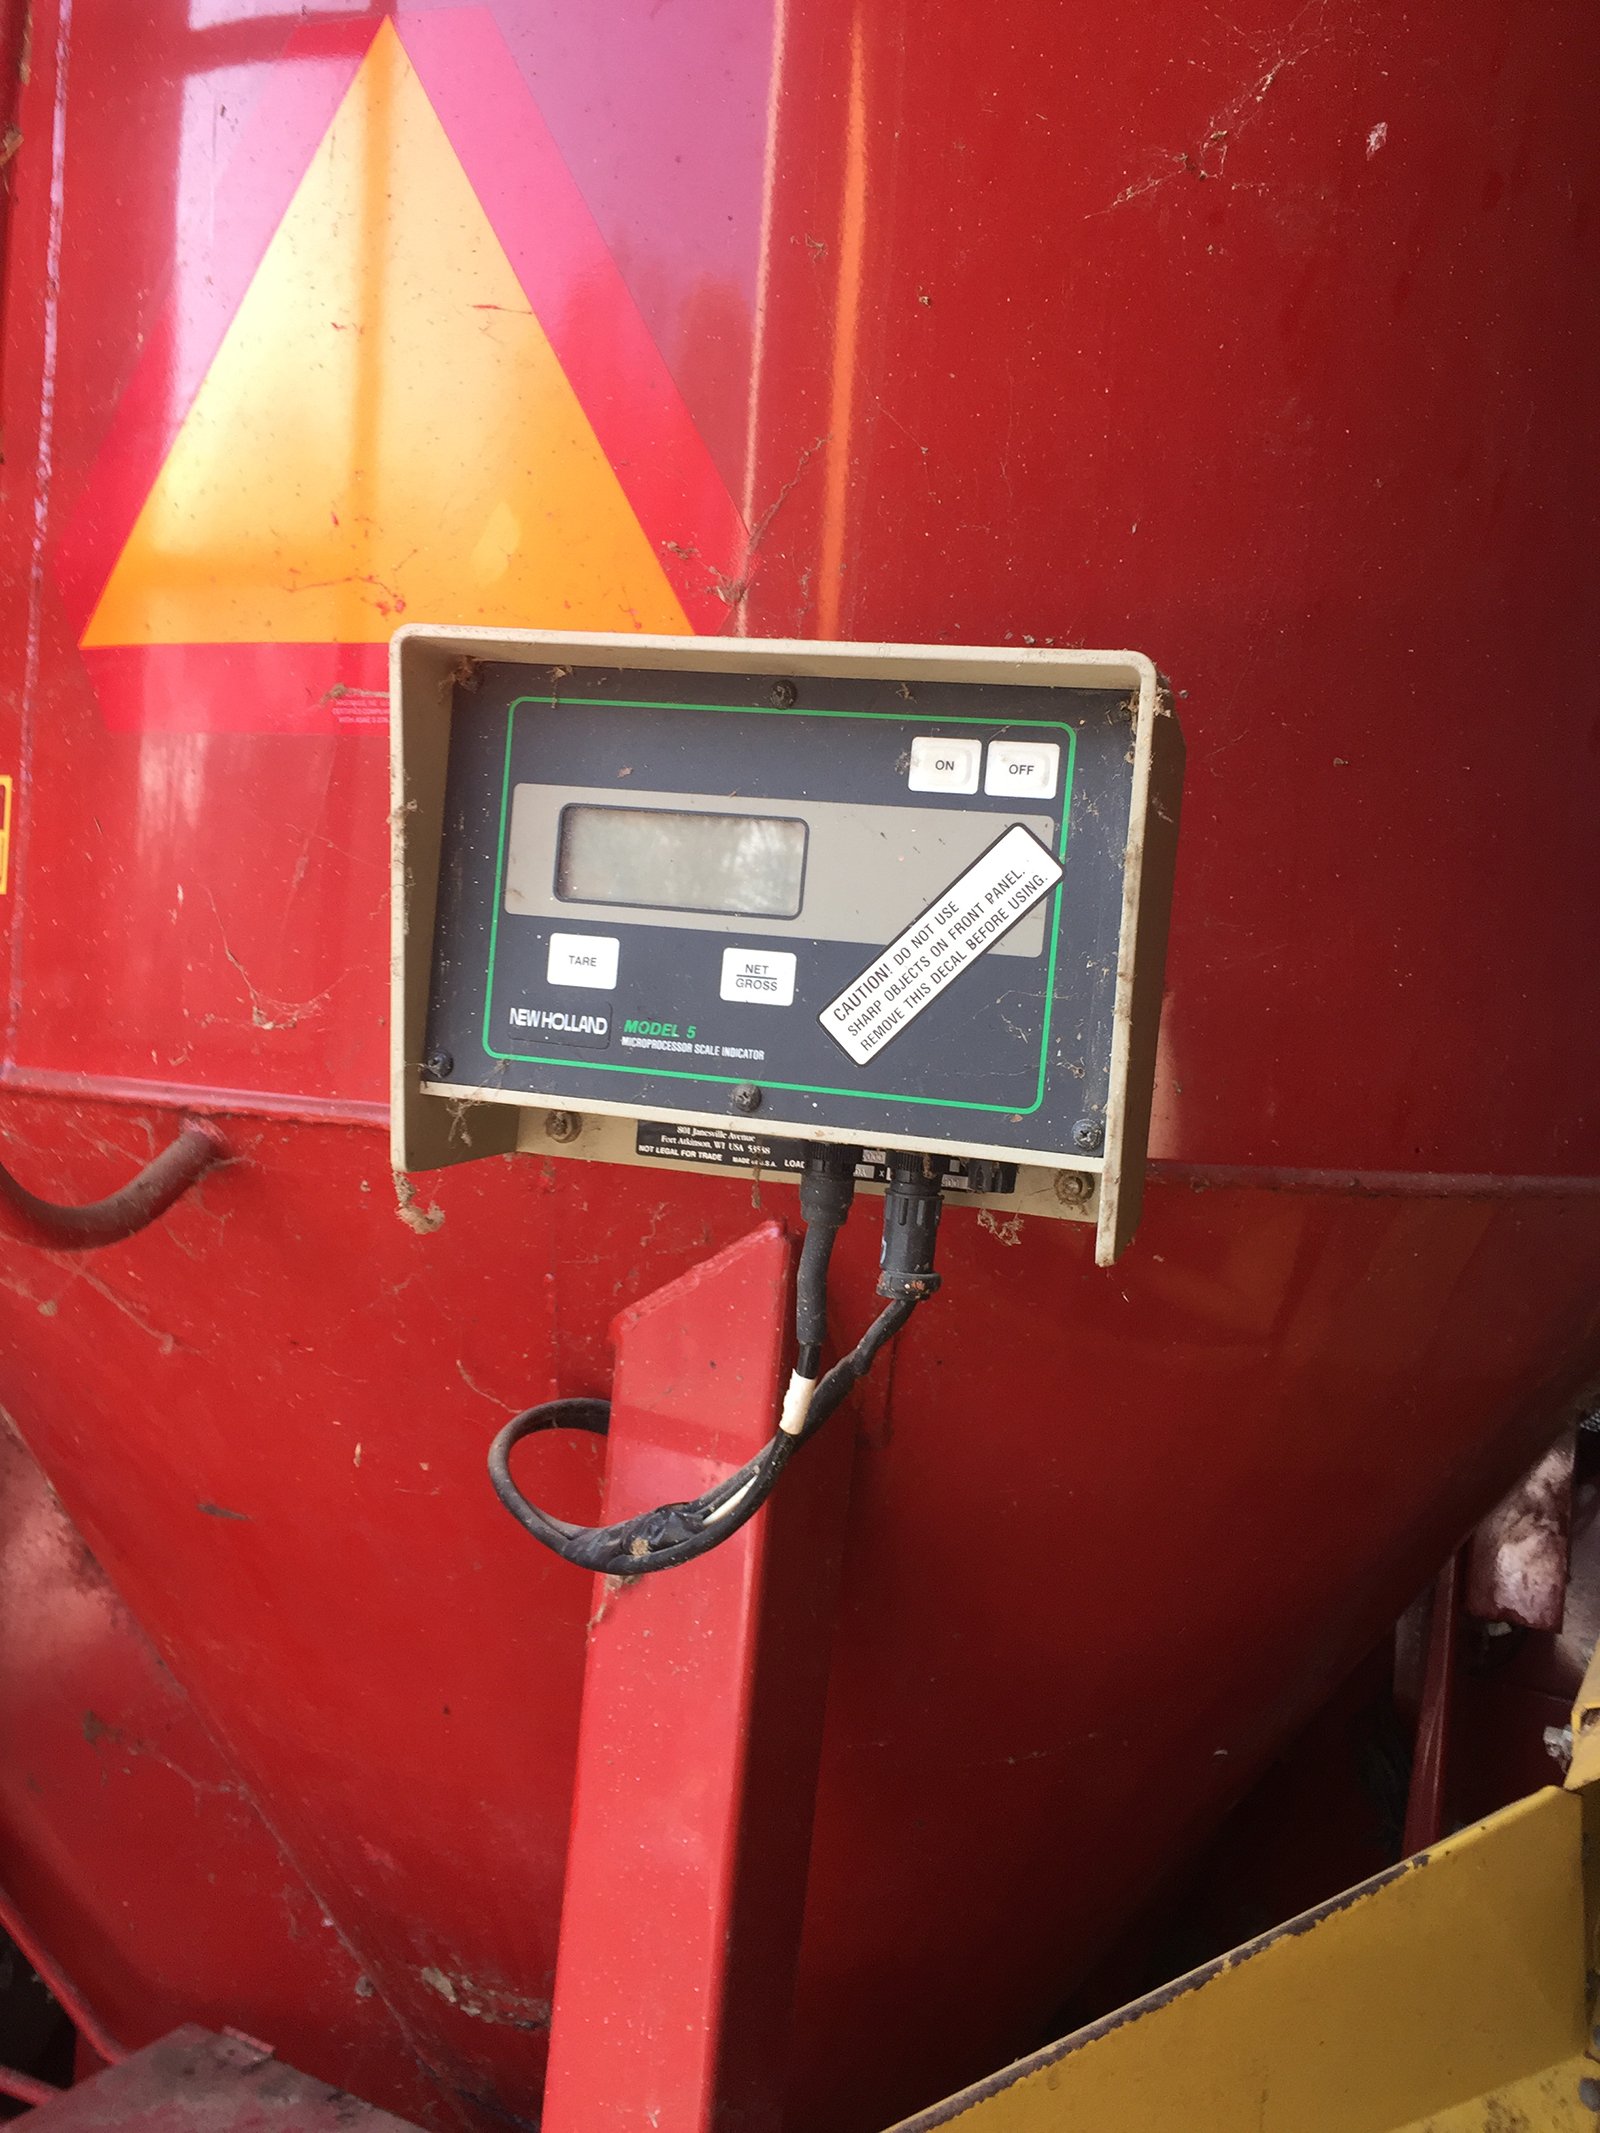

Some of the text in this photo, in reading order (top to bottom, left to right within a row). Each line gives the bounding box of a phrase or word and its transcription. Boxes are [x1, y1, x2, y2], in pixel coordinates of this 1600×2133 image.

[935, 760, 955, 771] ON
[1008, 764, 1035, 776] OFF
[568, 955, 598, 967] TARE
[833, 900, 960, 1021] CAUTION! DO NOT USE
[847, 870, 1026, 1037] SHARP OBJECTS ON FRONT PANEL.
[745, 964, 769, 975] NET
[860, 874, 1048, 1051] REMOVE THIS DECAL BEFORE USING.
[735, 978, 778, 991] GROSS
[623, 1019, 697, 1039] MODEL 5
[621, 1036, 765, 1061] MICROPROCESSOR SCALE INDICATOR
[661, 1135, 677, 1144] Fort
[728, 1142, 744, 1152] USA
[728, 1132, 756, 1142] Avenue
[638, 1144, 722, 1161] NOT LEGAL FOR TRADE
